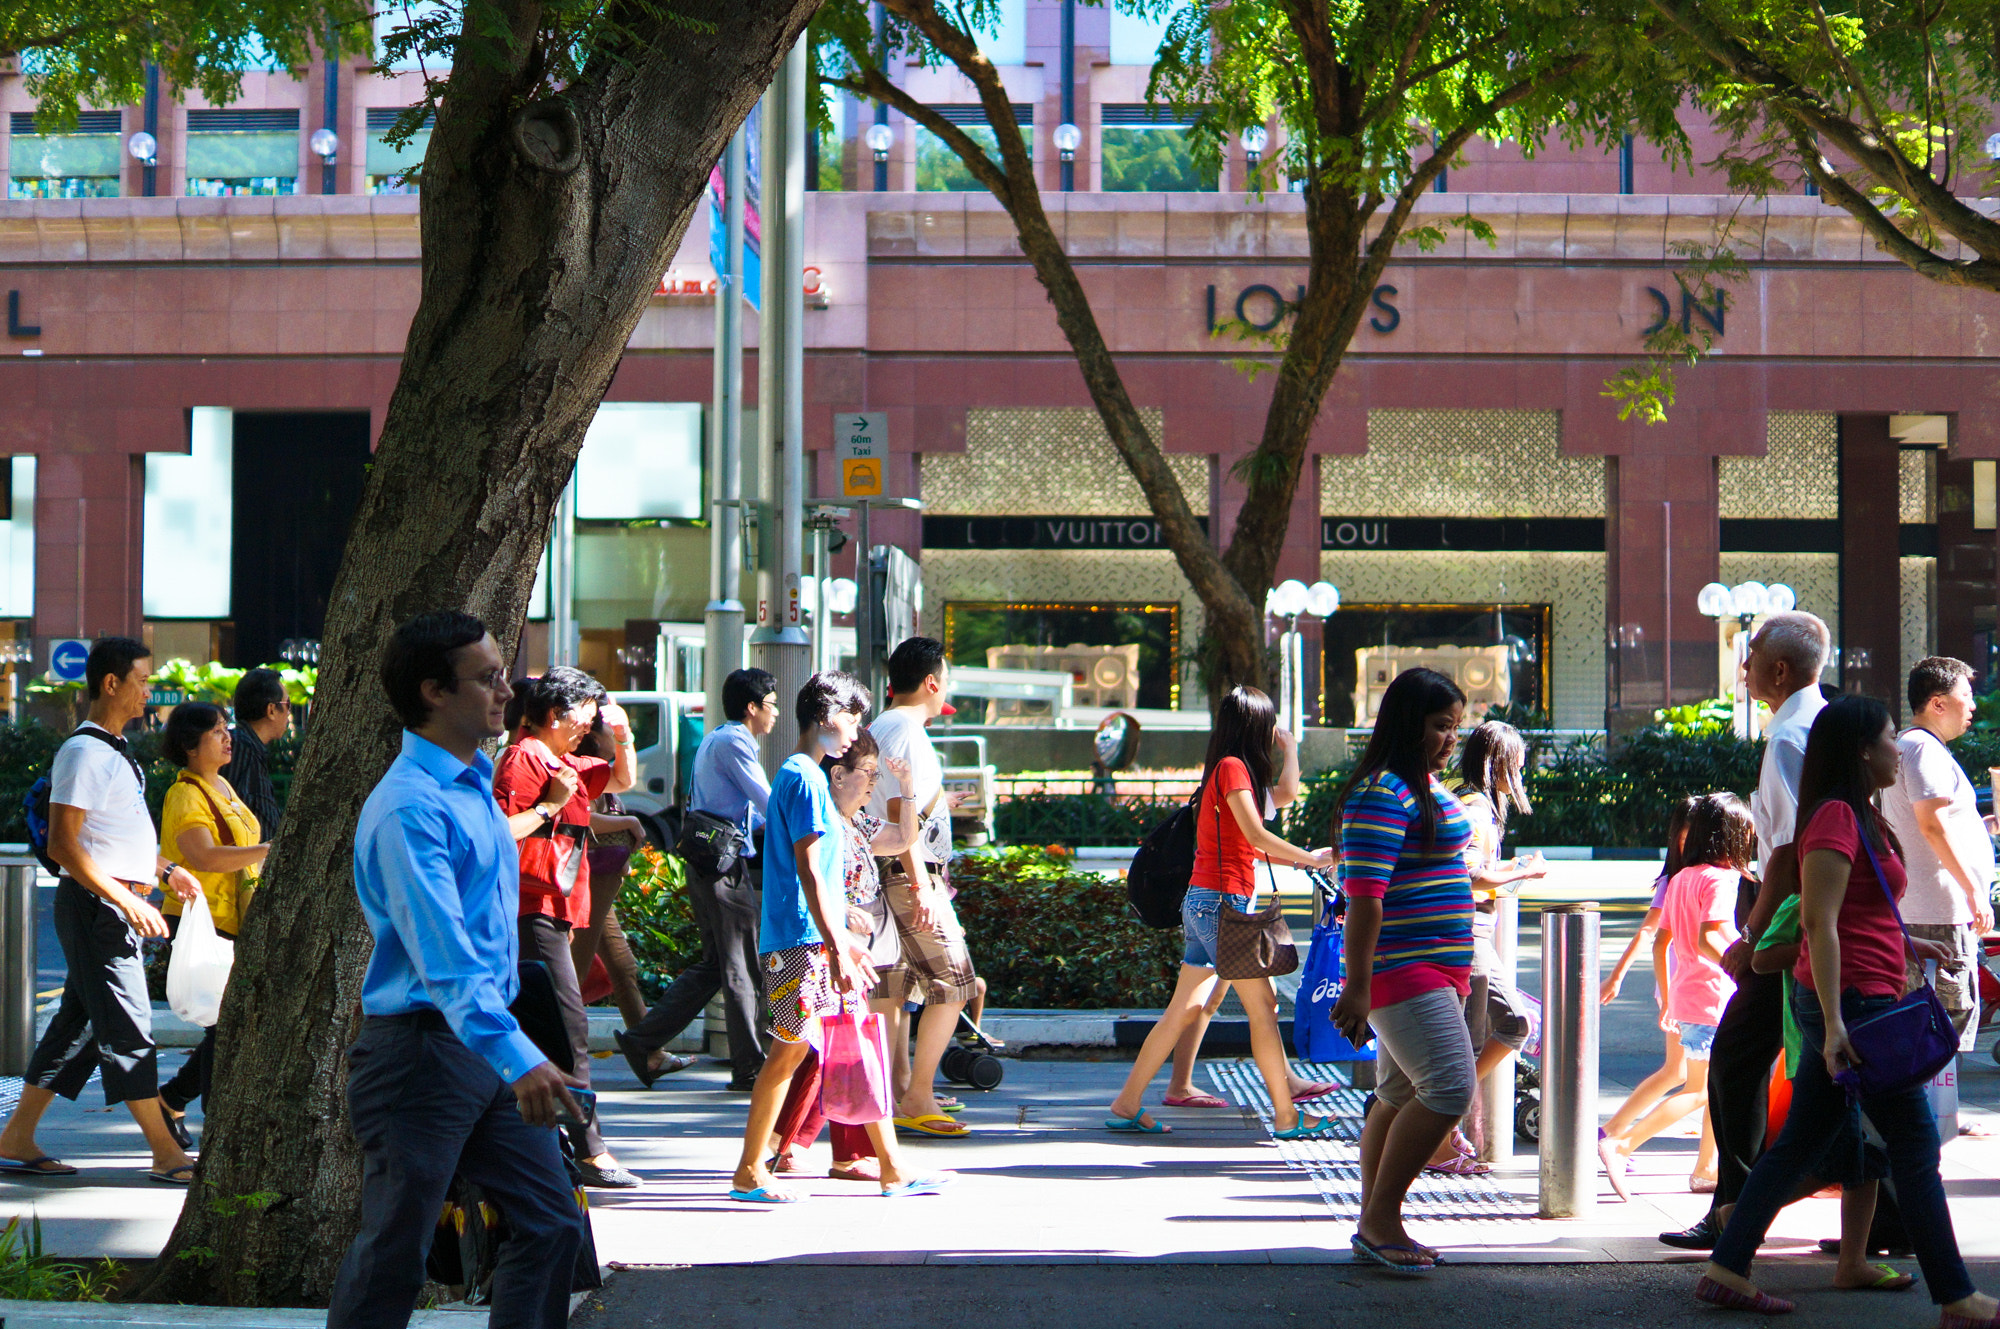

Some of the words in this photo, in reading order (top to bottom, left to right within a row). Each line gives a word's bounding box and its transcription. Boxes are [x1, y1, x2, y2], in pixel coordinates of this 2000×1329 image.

[851, 435, 872, 444] 60m
[852, 446, 871, 455] Taxi
[759, 600, 767, 622] 5
[790, 600, 798, 622] 5
